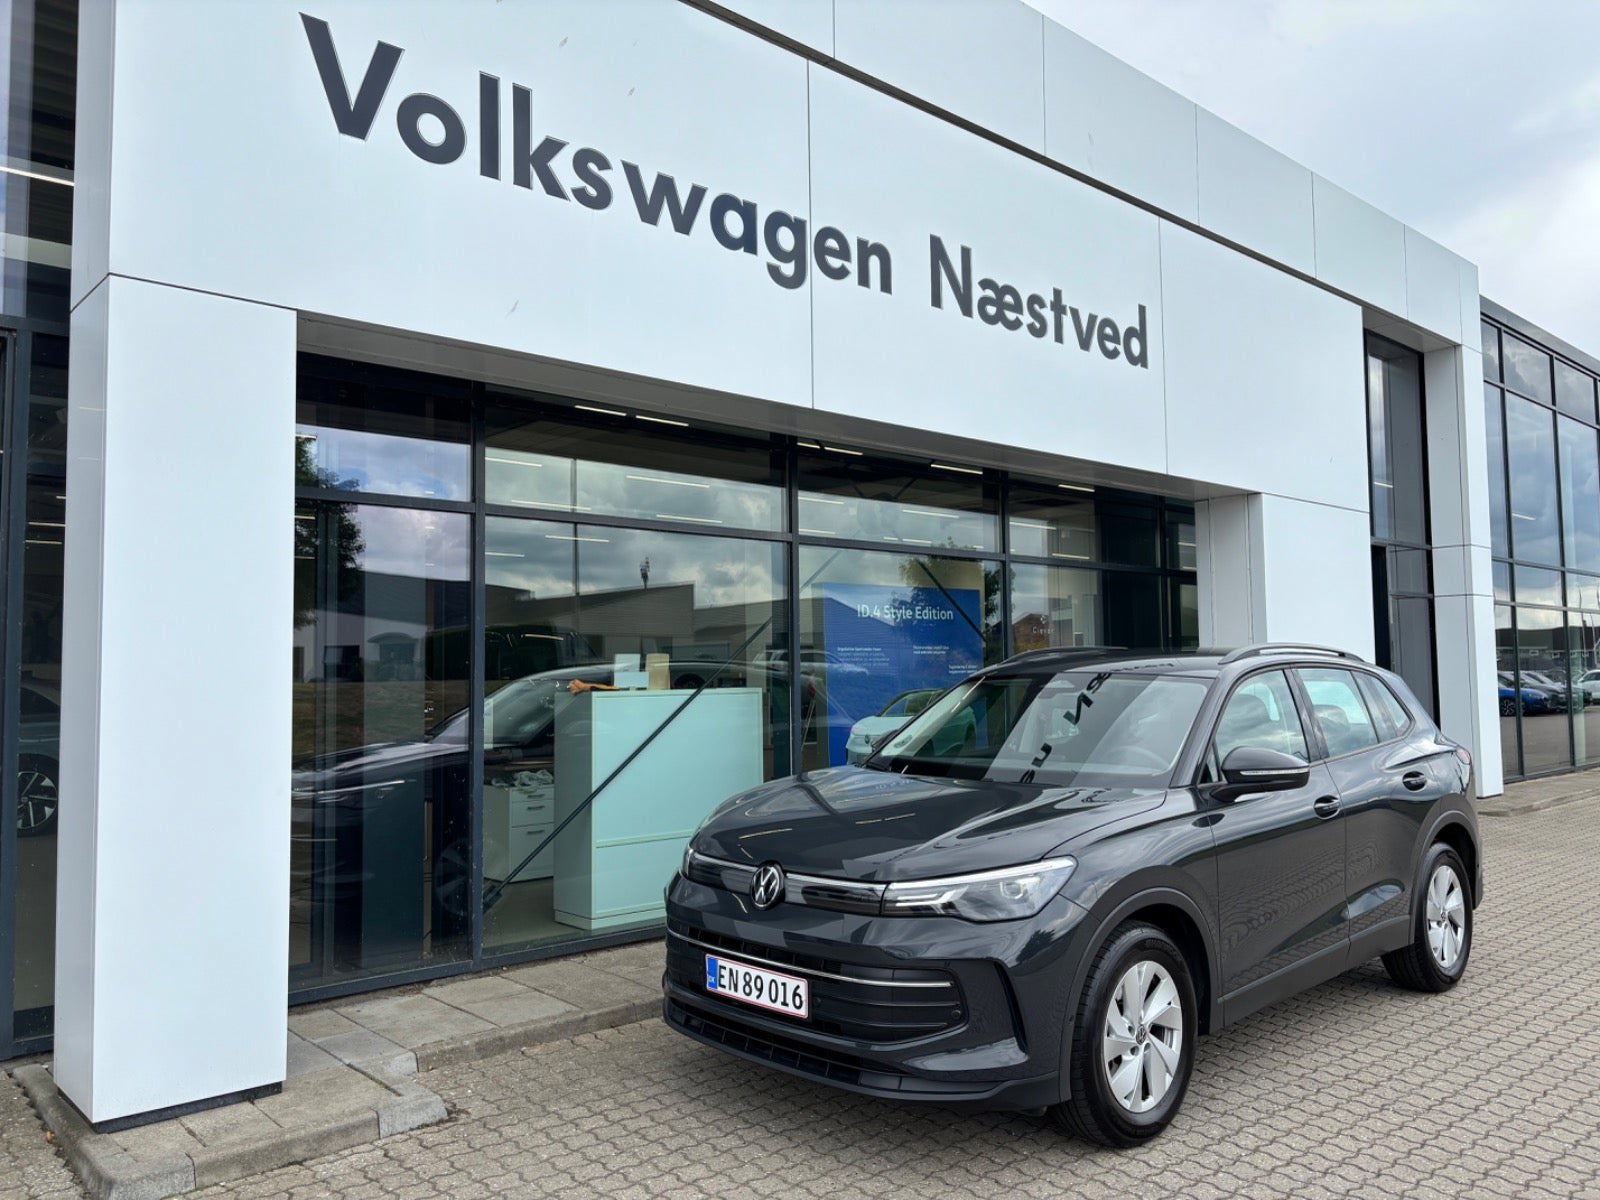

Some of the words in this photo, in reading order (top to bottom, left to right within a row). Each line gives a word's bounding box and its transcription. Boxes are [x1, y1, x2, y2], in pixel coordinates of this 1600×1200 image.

[299, 12, 893, 295] Volkswagen
[929, 233, 1149, 370] Næstved
[857, 604, 880, 618] ID.4
[883, 605, 913, 621] Style
[915, 606, 954, 620] Edition
[718, 964, 739, 993] EN
[742, 971, 764, 1000] 89
[768, 978, 804, 1010] 016
